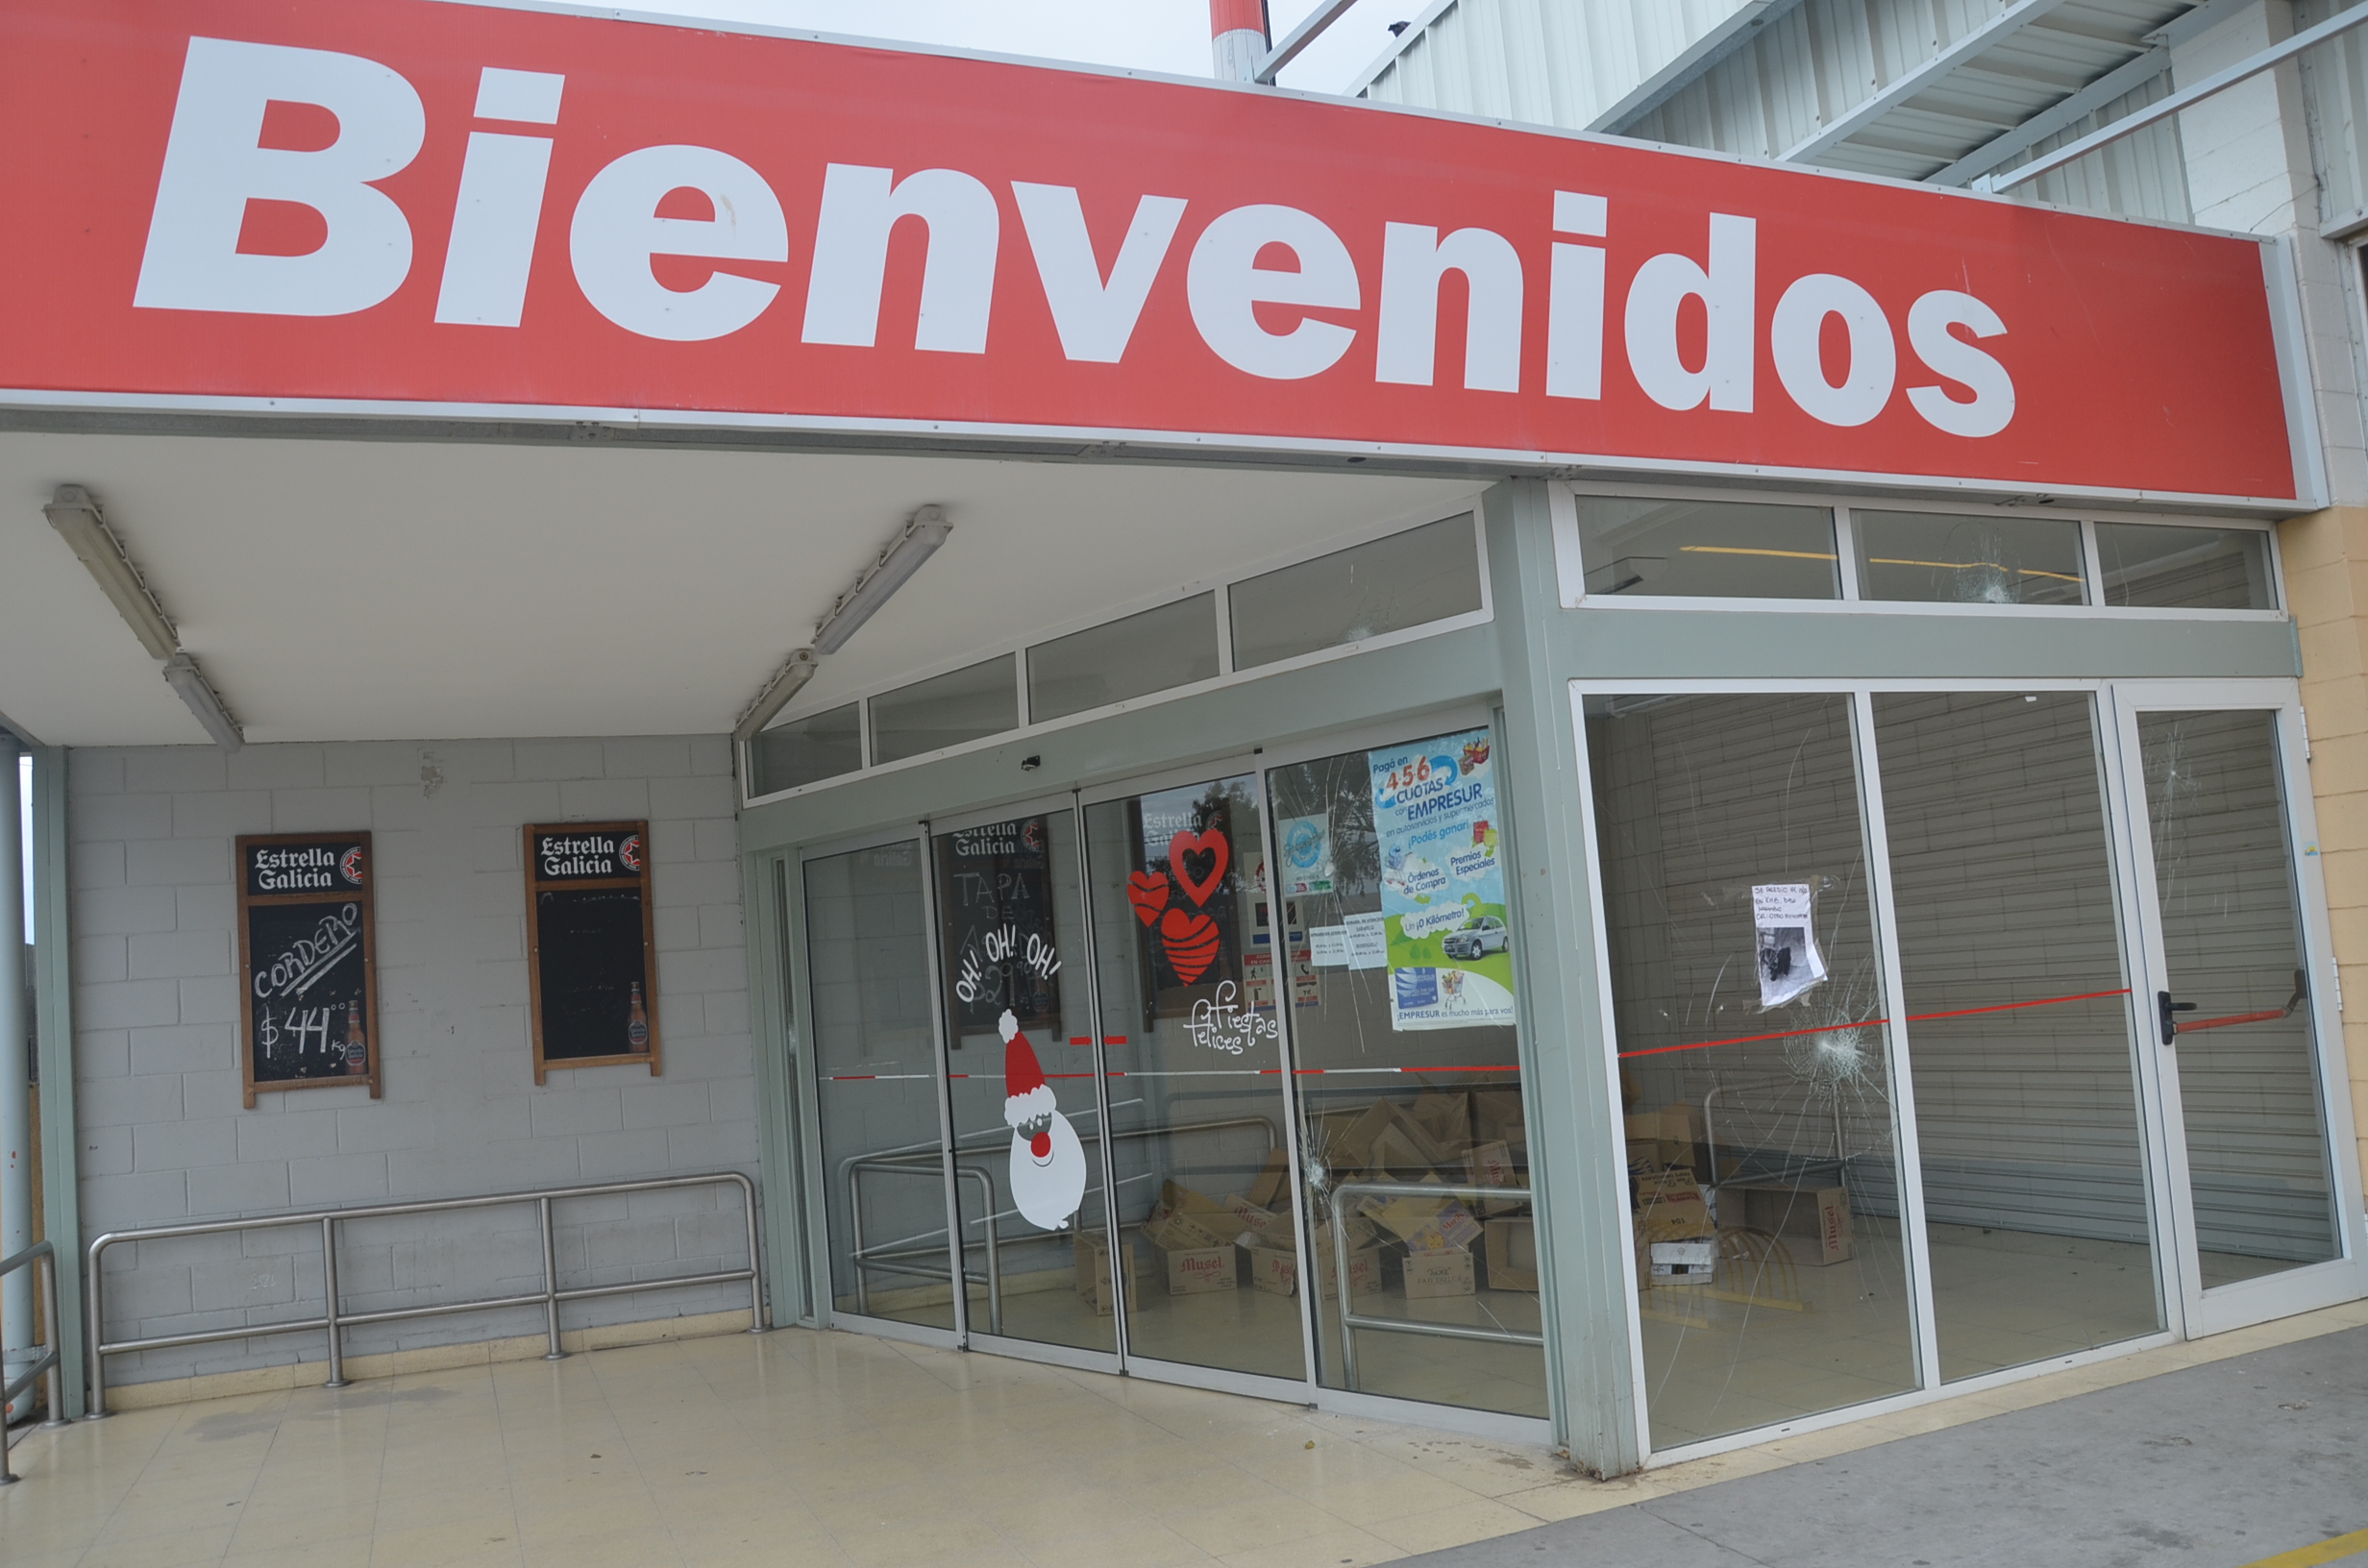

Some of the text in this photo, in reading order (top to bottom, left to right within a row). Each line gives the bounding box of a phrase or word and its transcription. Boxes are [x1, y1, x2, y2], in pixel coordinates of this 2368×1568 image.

[133, 36, 2016, 438] Bienvenidos
[1373, 756, 1408, 773] Pagá en
[1396, 777, 1443, 804] CUOTAS
[1394, 782, 1483, 821] con EMPRESUR
[1143, 812, 1202, 829] Estrella
[1396, 815, 1438, 835] autoservicios
[1440, 819, 1469, 840] ganar!
[541, 836, 615, 856] Estrella
[955, 837, 1016, 856] Galicia
[255, 848, 335, 870] Estrella
[545, 855, 612, 875] Galicia
[1450, 850, 1482, 867] Premios
[1456, 858, 1495, 876] Especiales
[259, 868, 333, 890] Galicia
[1403, 876, 1446, 894] de Compra
[1408, 869, 1440, 883] Órdenes
[952, 872, 1030, 906] TAPA
[981, 906, 1015, 919] DE
[1405, 922, 1415, 932] Un
[1426, 907, 1465, 926] Kilómetro!
[254, 902, 358, 998] CORDERO
[956, 950, 982, 1003] OH!
[985, 922, 1017, 963] OH!
[1026, 933, 1062, 981] OH!
[1449, 1008, 1469, 1017] mucho
[1500, 1006, 1514, 1015] vos!
[1825, 1205, 1838, 1250] Musel
[1180, 1256, 1221, 1273] Musel
